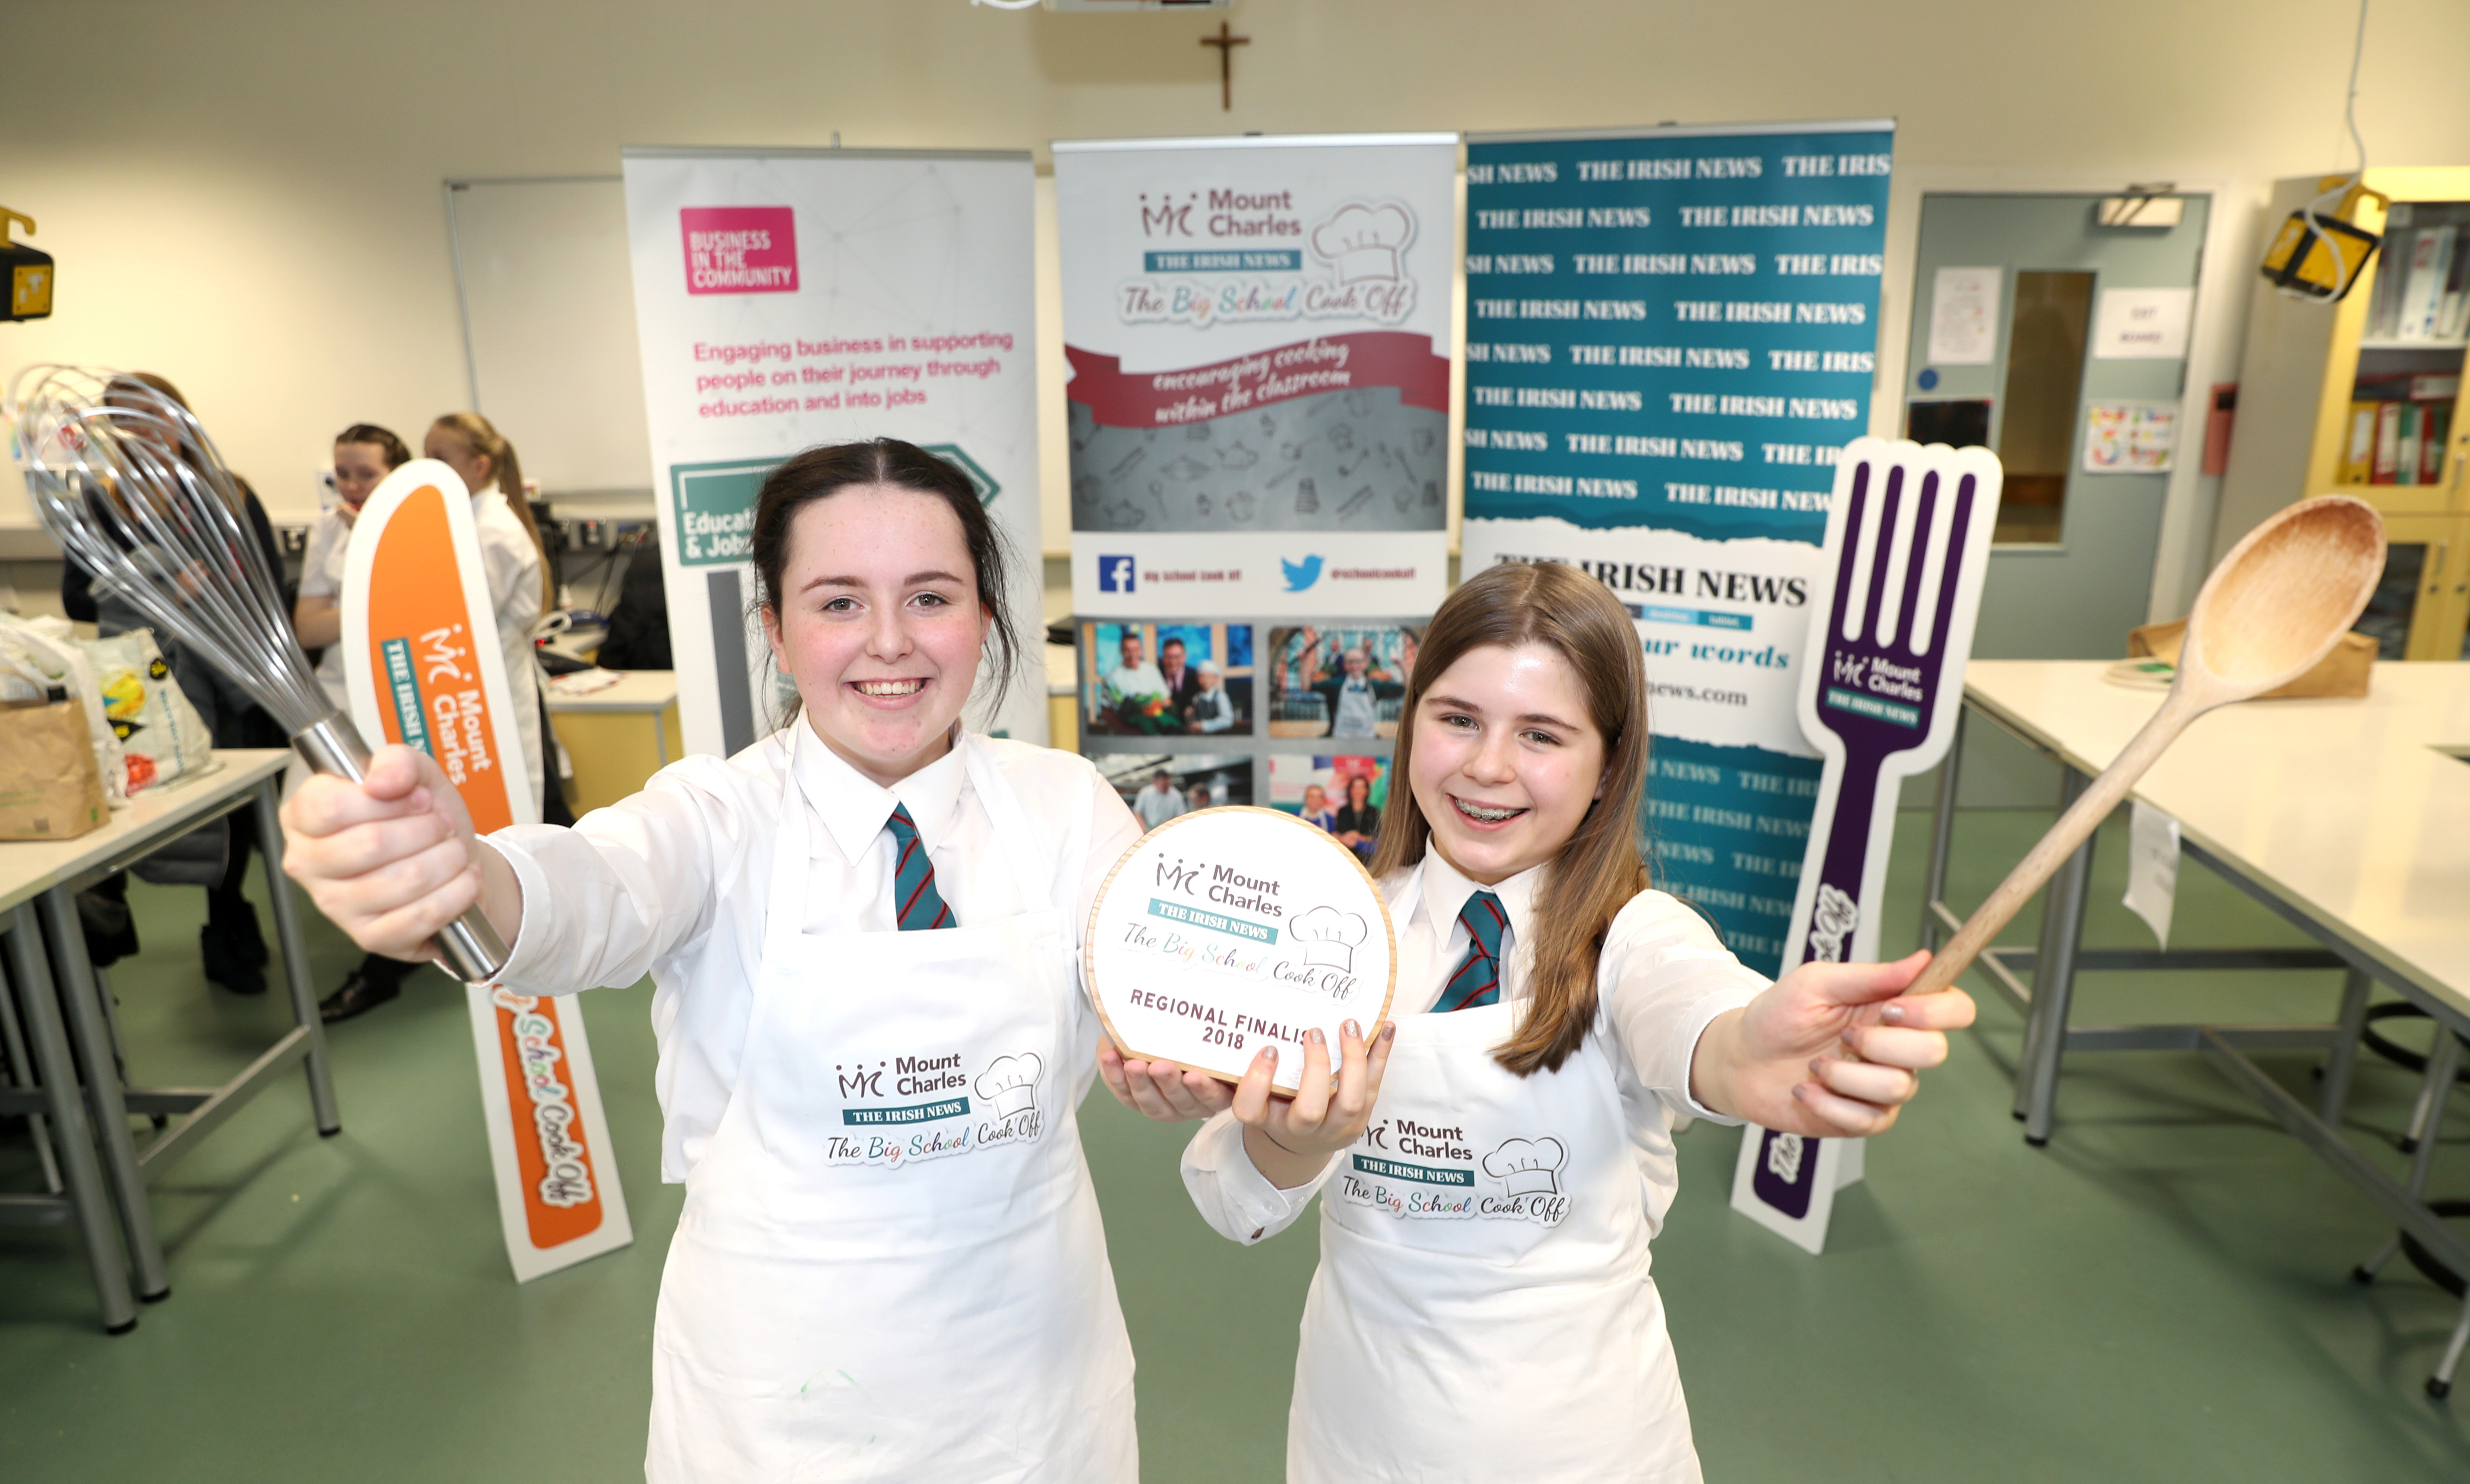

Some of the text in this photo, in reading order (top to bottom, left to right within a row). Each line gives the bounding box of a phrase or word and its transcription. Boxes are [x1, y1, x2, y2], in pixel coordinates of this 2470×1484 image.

[1497, 163, 1557, 182] NEWS
[1577, 157, 1762, 181] THE IRISH NEWS
[1783, 156, 1833, 176] THE
[1209, 190, 1292, 211] Mount
[1209, 215, 1302, 236] Charles
[1477, 208, 1650, 229] THE IRISH NEWS
[1680, 205, 1874, 226] THE IRISH NEWS
[690, 230, 771, 250] BUSINESS
[692, 250, 747, 268] IN THE
[1157, 252, 1290, 269] THE IRISH NEWS
[1495, 255, 1554, 274] NEWS
[1574, 254, 1756, 275] THE IRISH NEWS
[1776, 254, 1827, 275] THE
[694, 266, 792, 288] COMMUNITY
[1125, 288, 1164, 314] The
[1173, 287, 1210, 319] Big
[1220, 285, 1296, 314] School
[1475, 299, 1646, 320] THE IRISH NEWS
[1675, 301, 1866, 324] THE IRISH NEWS
[695, 331, 1013, 363] Engaging business in supporting
[1493, 344, 1551, 363] NEWS
[1570, 345, 1750, 369] THE IRISH NEWS
[1153, 339, 1349, 389] encouraging cooking
[1769, 350, 1819, 371] THE
[697, 358, 1000, 394] people on their journey through
[700, 388, 926, 418] education and into jobs
[1156, 372, 1351, 423] within the classroom
[1474, 386, 1642, 411] THE IRISH NEWS
[1669, 393, 1857, 419] THE IRISH NEWS
[1491, 430, 1548, 451] NEWS
[1566, 433, 1744, 461] THE IRISH NEWS
[1762, 442, 1812, 464] THE
[1472, 471, 1638, 499] THE IRISH NEWS
[1665, 482, 1833, 511] THE IRISH NEW
[683, 508, 754, 534] Educat
[686, 536, 703, 558] &
[1697, 570, 1808, 607] NEWS
[387, 640, 410, 683] THE
[1645, 639, 1790, 668] ur words
[1871, 656, 1922, 684] Mount
[1868, 673, 1923, 702] Charles
[395, 683, 422, 738] IRISH
[433, 694, 468, 786] Charles
[456, 689, 492, 773] Mount
[1662, 762, 1720, 783] NEWS
[1738, 770, 1785, 794] THE
[1693, 804, 1752, 830] IRISH
[1732, 851, 1777, 872] THE
[1212, 864, 1280, 896] Mount
[1208, 885, 1283, 917] Charles
[1686, 883, 1746, 909] IRISH
[1749, 894, 1794, 918] NEW
[1158, 903, 1268, 940] THE IRISH NEWS
[1123, 922, 1156, 948] The
[1163, 932, 1196, 962] Big
[1202, 942, 1268, 974] School
[1725, 931, 1770, 952] THE
[1130, 988, 1308, 1045] REGIONAL FINALIS
[1202, 1026, 1244, 1050] 2018
[520, 1017, 561, 1097] School
[896, 1054, 961, 1075] Mount
[896, 1072, 967, 1096] Charles
[853, 1101, 961, 1123] THE IRISH NEWS
[1397, 1119, 1463, 1141] Mount
[827, 1137, 861, 1159] The
[868, 1136, 903, 1163] Big
[908, 1126, 970, 1157] School
[1399, 1138, 1472, 1160] Charles
[1361, 1158, 1465, 1183] THE IRISH NEWS
[1343, 1176, 1371, 1199] The
[1375, 1186, 1403, 1213] Big
[1408, 1192, 1471, 1213] School
